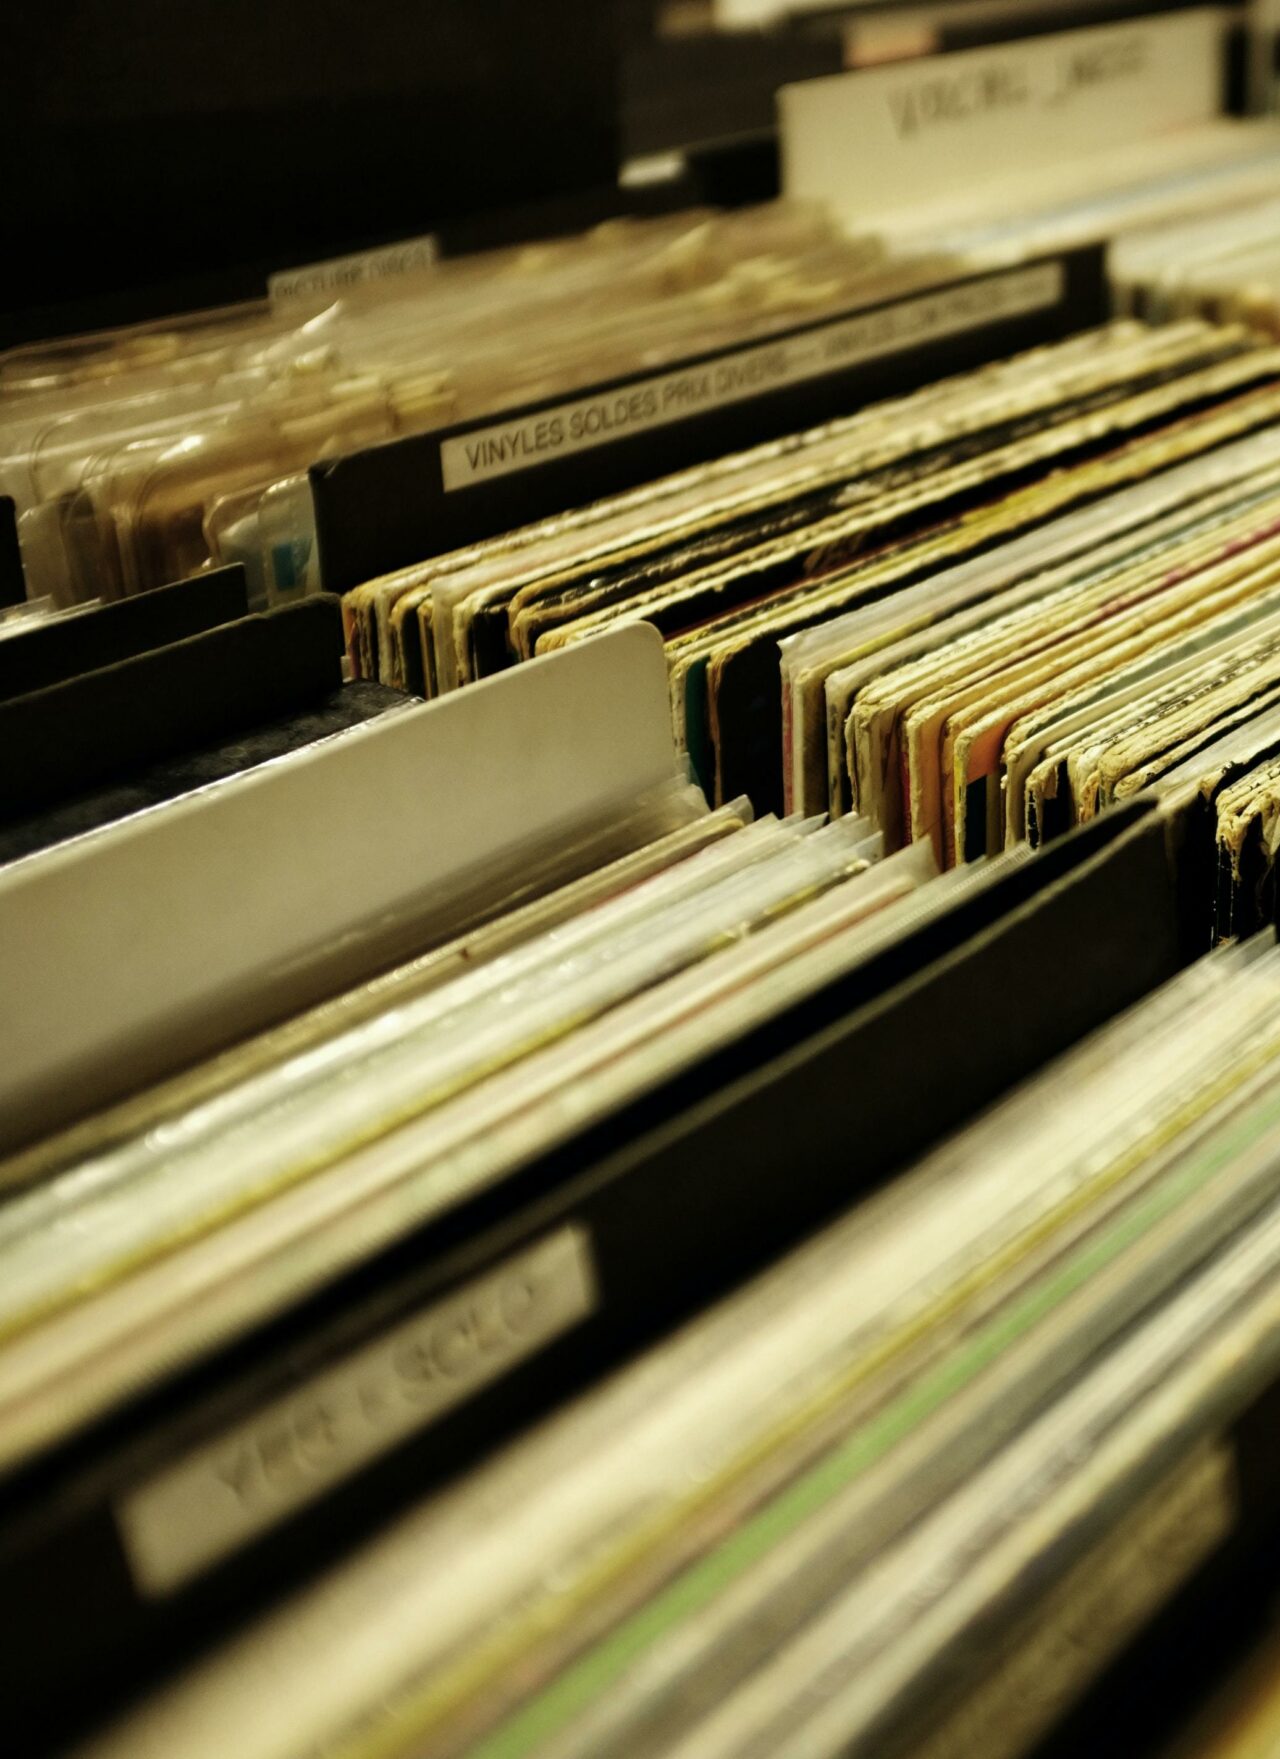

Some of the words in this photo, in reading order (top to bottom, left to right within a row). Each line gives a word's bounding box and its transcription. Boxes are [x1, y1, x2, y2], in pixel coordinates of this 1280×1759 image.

[465, 417, 565, 471] VINYLES
[568, 394, 658, 441] SOLDES
[660, 377, 711, 411] PRIX
